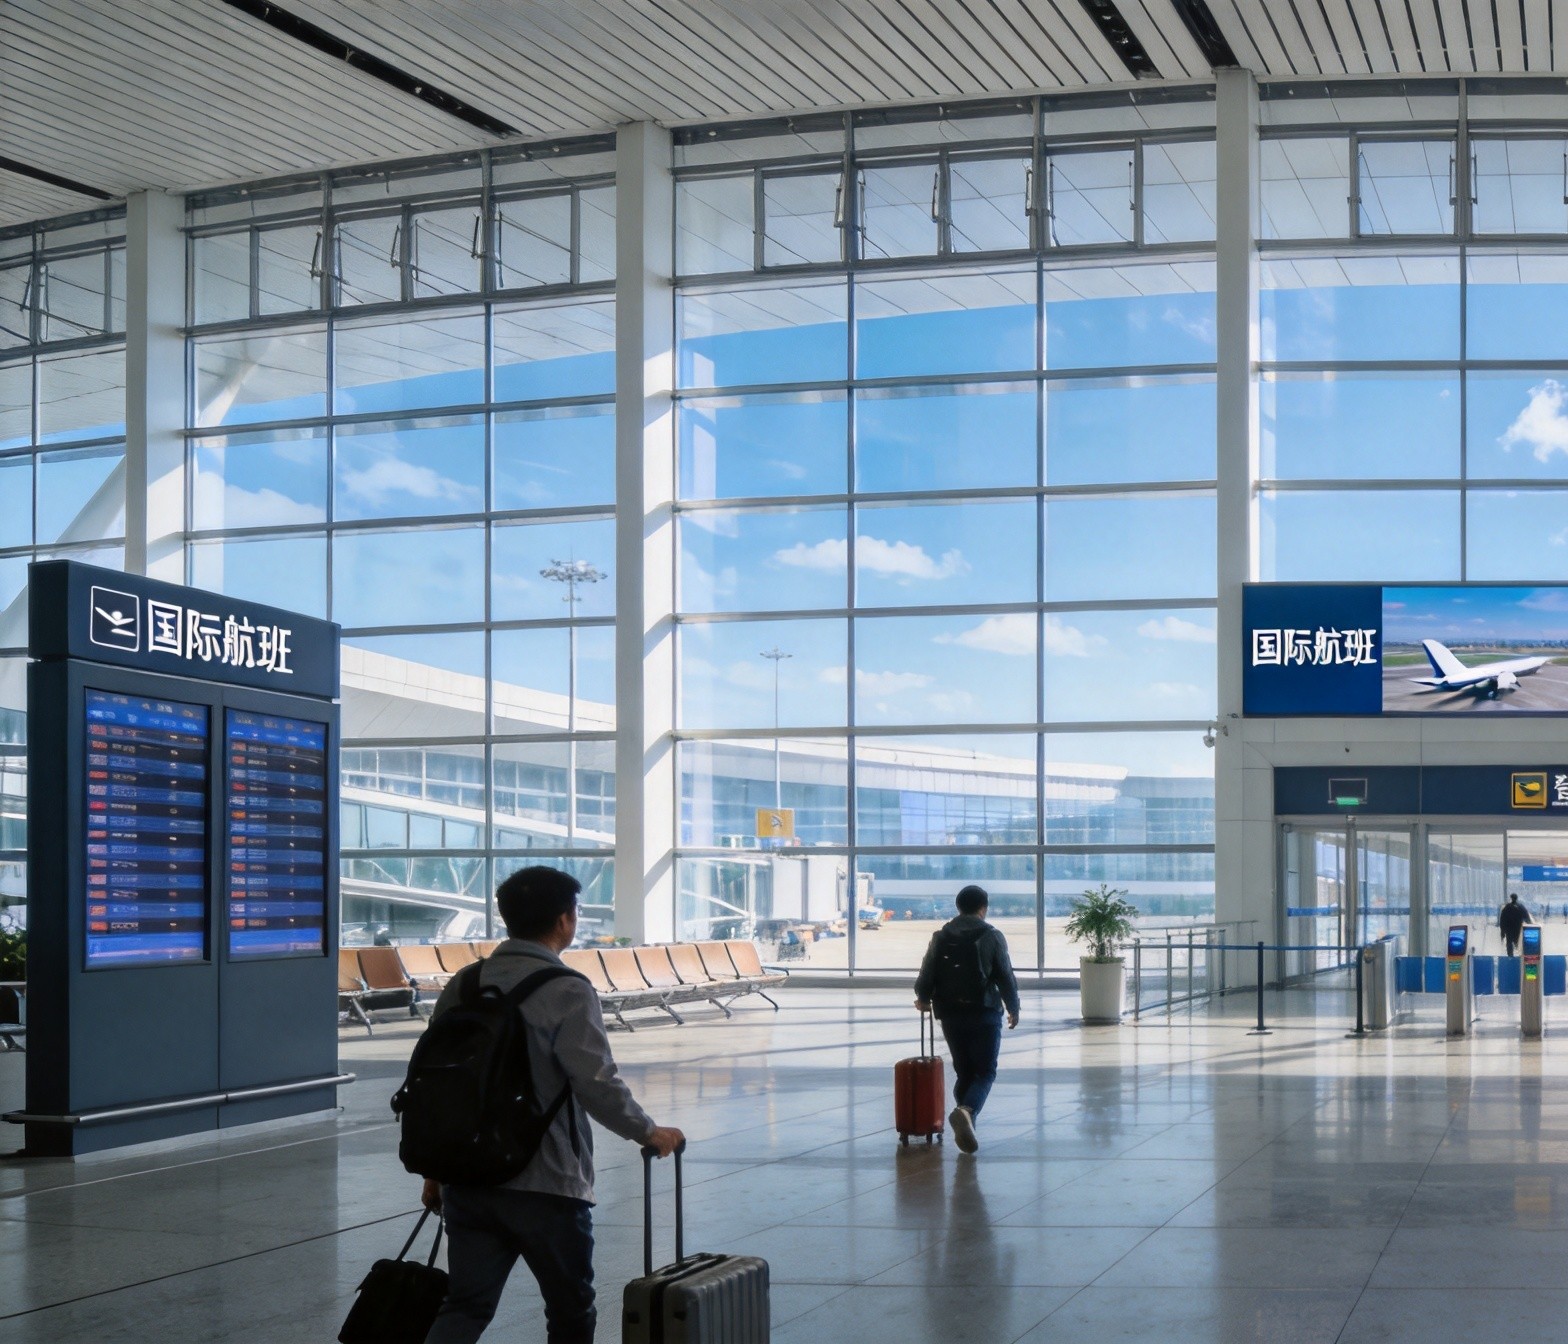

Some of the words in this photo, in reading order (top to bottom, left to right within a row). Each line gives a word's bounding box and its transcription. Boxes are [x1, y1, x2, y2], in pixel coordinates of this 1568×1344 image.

[147, 598, 294, 674] 国际航班
[1252, 626, 1377, 667] 国际航班
